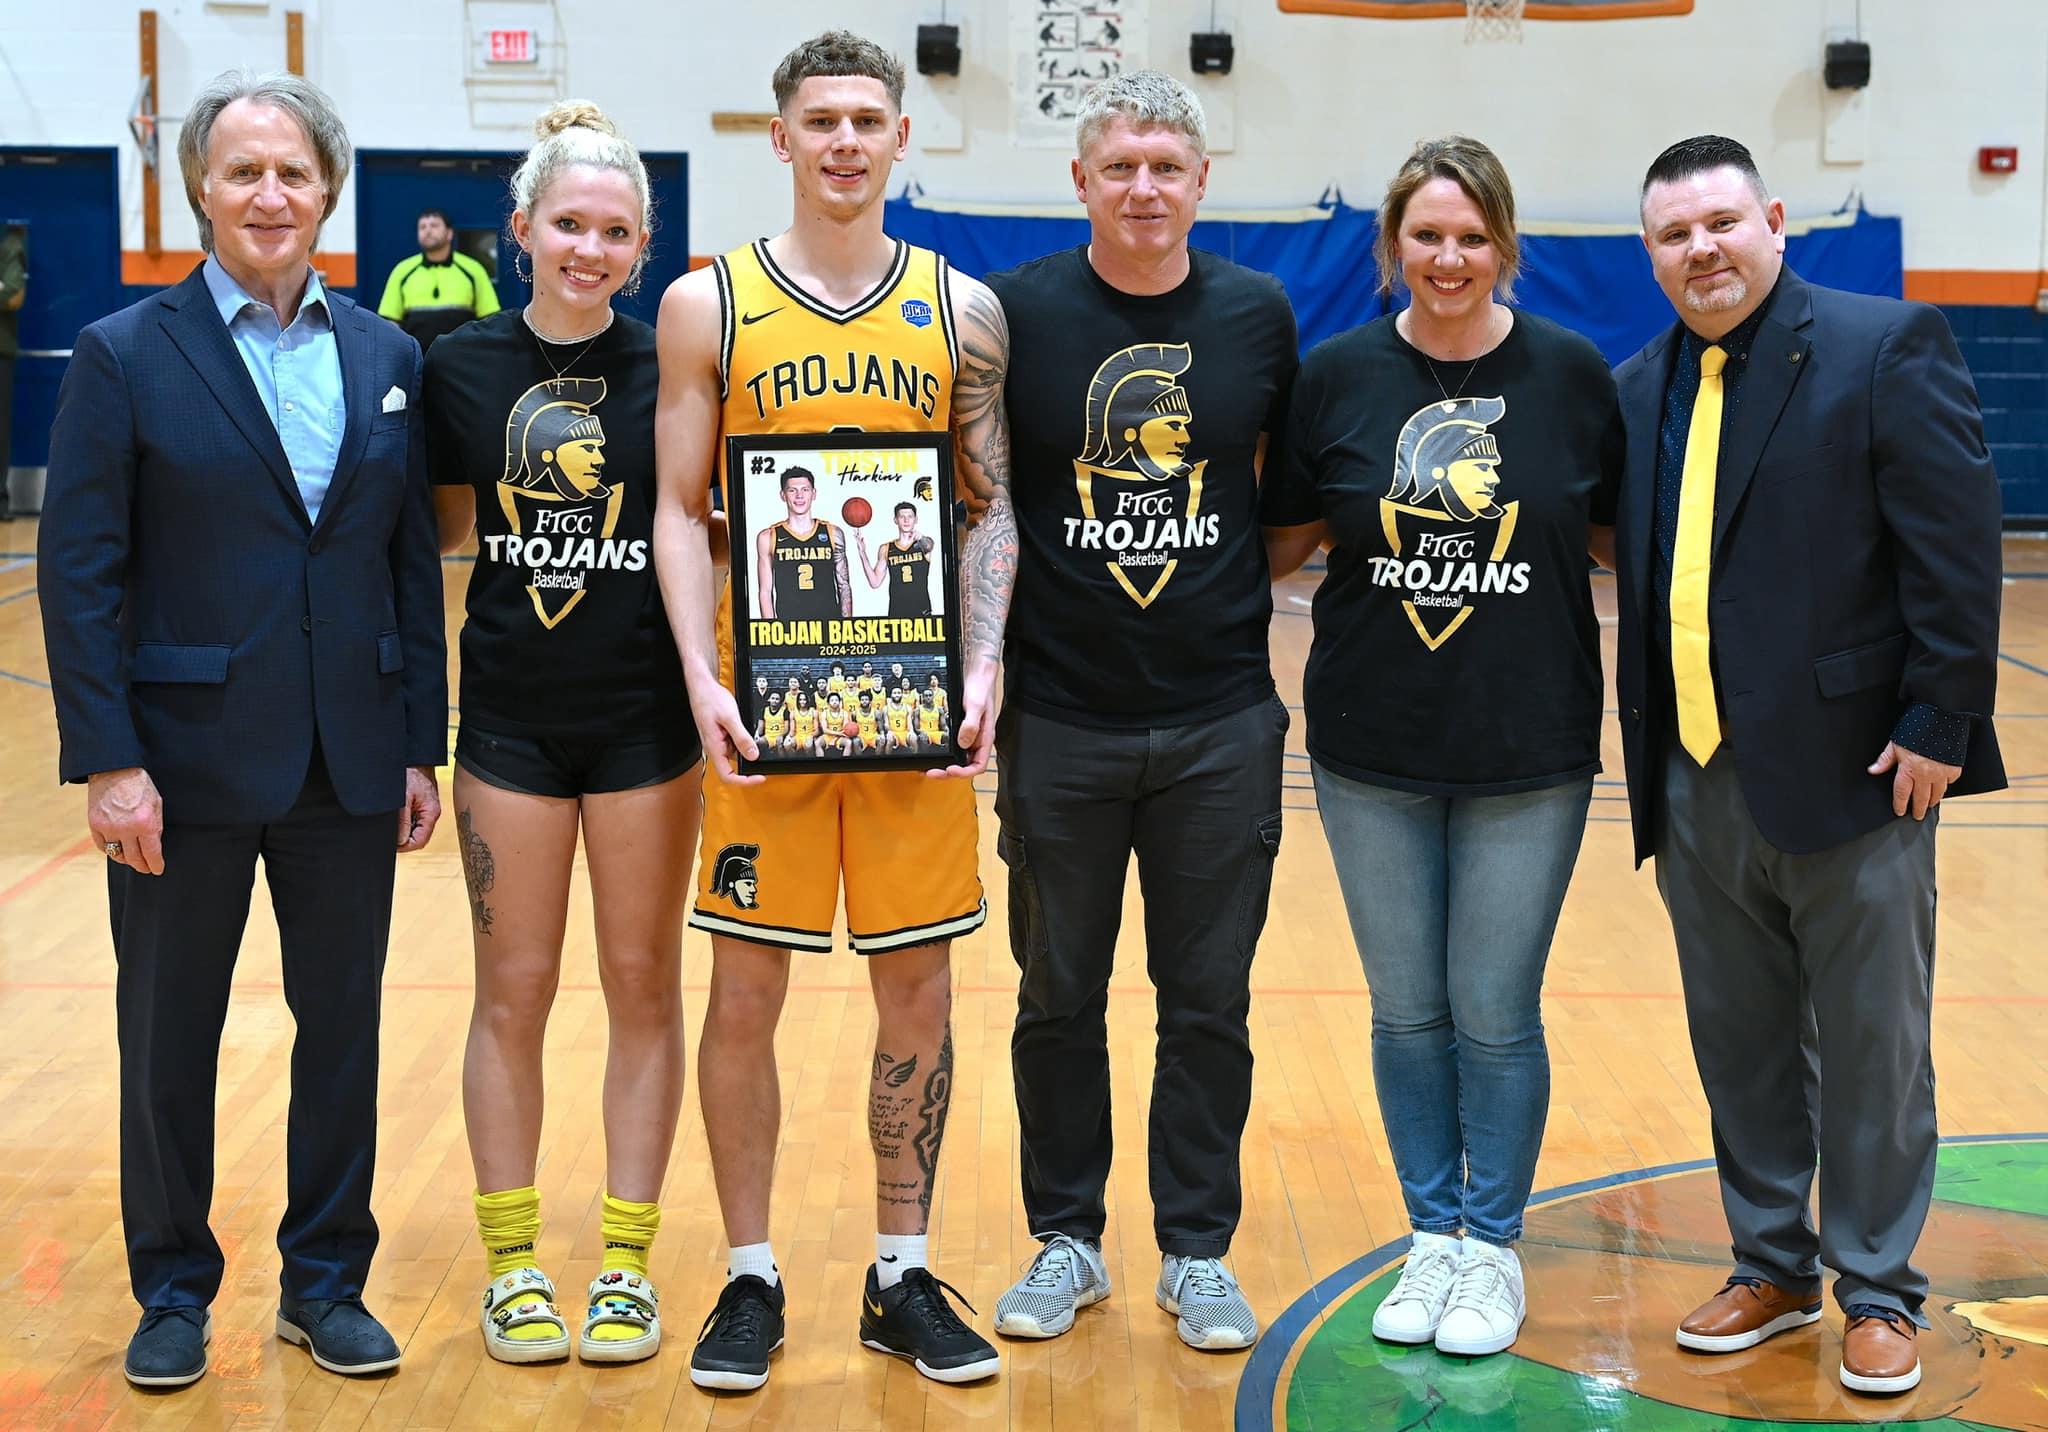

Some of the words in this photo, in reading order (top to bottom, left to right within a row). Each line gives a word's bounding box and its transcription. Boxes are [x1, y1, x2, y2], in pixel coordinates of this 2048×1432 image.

[491, 31, 528, 59] EXIT
[901, 303, 932, 318] NJCAA
[746, 352, 940, 419] TROJANS
[751, 456, 776, 475] #2
[819, 450, 919, 474] TRISTIN
[838, 463, 902, 486] Harkins
[1114, 488, 1173, 517] FTCC
[533, 506, 593, 534] FTCC
[1063, 513, 1220, 551] TROJANS
[484, 534, 648, 571] TROJANS
[776, 547, 832, 561] TROJANS
[1414, 531, 1475, 559] FTCC
[888, 551, 923, 566] TROJANS
[1118, 551, 1169, 566] Basketball
[533, 569, 586, 590] Basketball
[798, 563, 814, 590] 2
[902, 565, 913, 583] 2
[1367, 556, 1532, 594] TROJANS
[1413, 591, 1465, 608] Basketball
[750, 621, 823, 646] TROJAN
[828, 618, 946, 645] BASKETBALL
[819, 644, 877, 656] 2024-2025
[895, 720, 901, 728] 5
